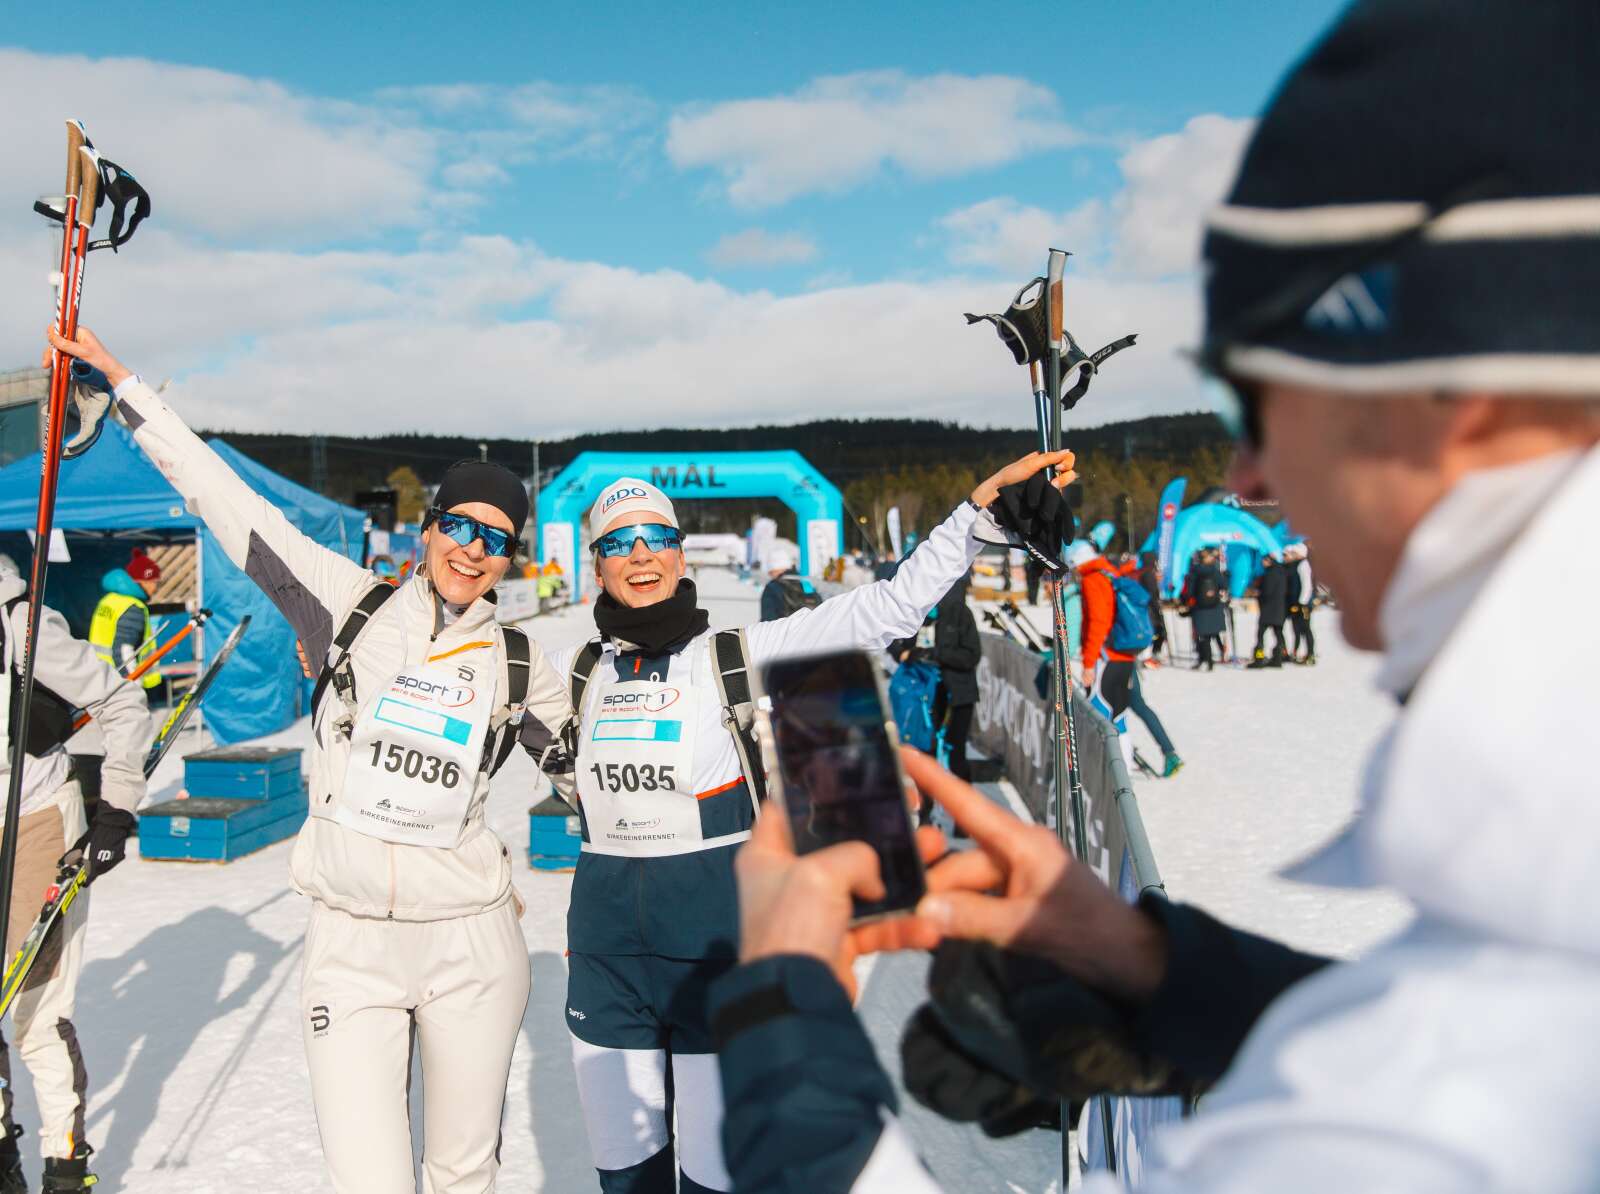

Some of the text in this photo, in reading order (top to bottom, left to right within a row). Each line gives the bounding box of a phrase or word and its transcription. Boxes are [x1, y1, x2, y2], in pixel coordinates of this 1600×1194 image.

[652, 462, 727, 488] MÅL
[606, 487, 647, 507] BDO
[395, 675, 463, 702] sport 1
[602, 693, 666, 706] sport 1
[369, 740, 461, 789] 15036
[590, 763, 676, 793] 15035
[360, 808, 435, 831] BIRKEBEINERRENNET
